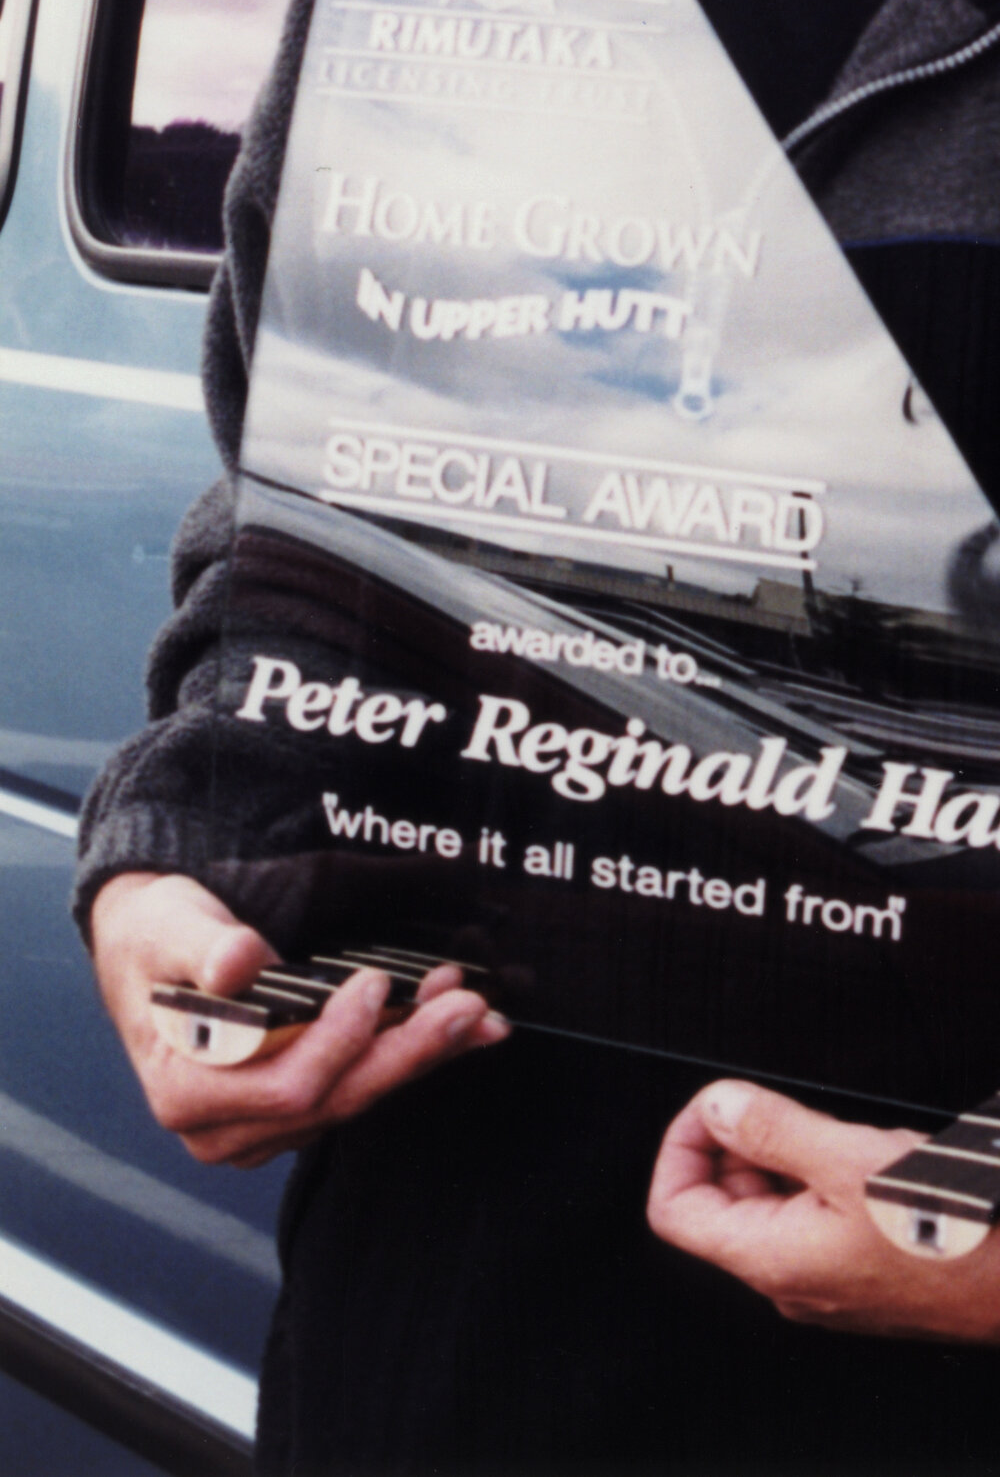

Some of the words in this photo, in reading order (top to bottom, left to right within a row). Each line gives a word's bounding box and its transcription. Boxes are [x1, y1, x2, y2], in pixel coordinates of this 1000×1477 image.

[367, 11, 614, 70] RIMUTAKA
[356, 267, 404, 332] IN
[410, 295, 550, 340] UPPER
[559, 288, 693, 339] HUTT
[323, 434, 568, 520] SPECIAL
[582, 472, 825, 553] AWARD
[469, 617, 644, 678] awarded
[654, 638, 722, 689] to...
[237, 656, 447, 750] Peter
[462, 694, 848, 822] Reginald
[323, 793, 463, 859] "where
[479, 829, 507, 869] it
[524, 842, 574, 882] all
[591, 855, 767, 918] started
[786, 885, 906, 941] from"
